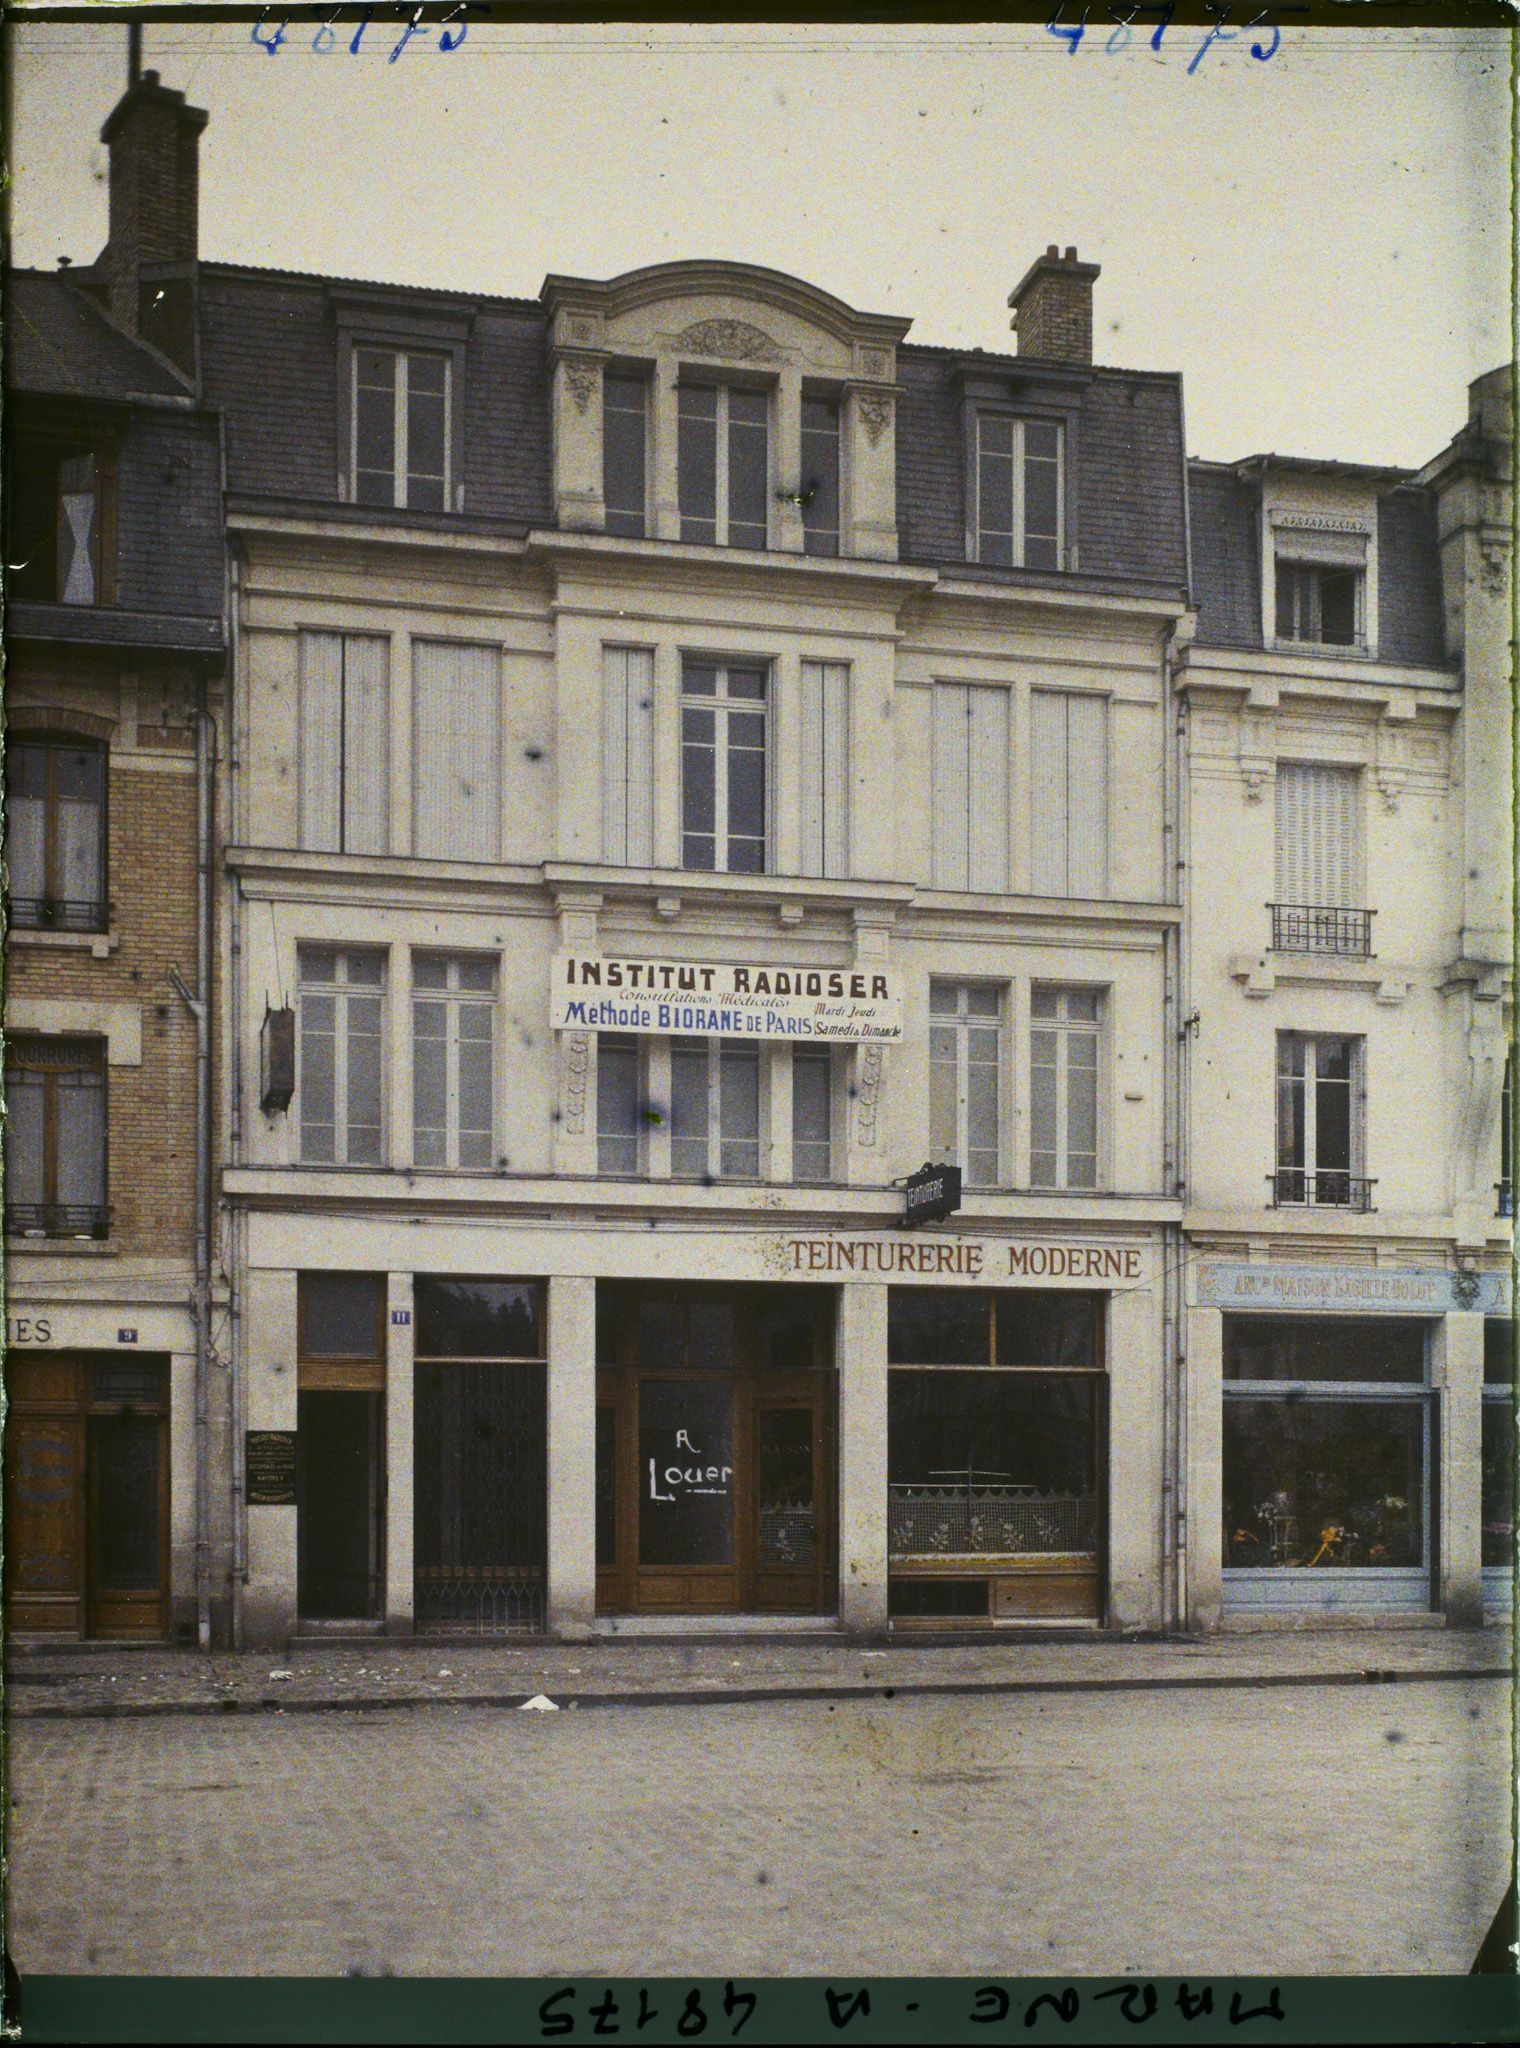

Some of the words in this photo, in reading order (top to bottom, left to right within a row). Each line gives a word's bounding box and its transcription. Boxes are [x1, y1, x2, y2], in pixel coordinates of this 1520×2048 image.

[567, 959, 715, 992] INSTITUT
[733, 968, 889, 1000] RADIOSER
[619, 988, 712, 1004] Consultations
[564, 1000, 650, 1027] Méthode
[658, 1004, 742, 1031] BIORANE
[747, 1015, 761, 1032] DE
[766, 1011, 812, 1035] PARIS
[815, 1003, 845, 1016] Mardi
[848, 1003, 876, 1018] Jeudi
[815, 1021, 854, 1036] Samedi
[788, 1240, 983, 1275] TEINTURERIE
[1008, 1246, 1142, 1279] MODERNE
[124, 1331, 132, 1341] 9
[650, 1458, 733, 1501] Louer
[539, 1981, 757, 2037] 48175
[825, 1987, 871, 2029] A
[969, 1983, 1285, 2028] MARNE
